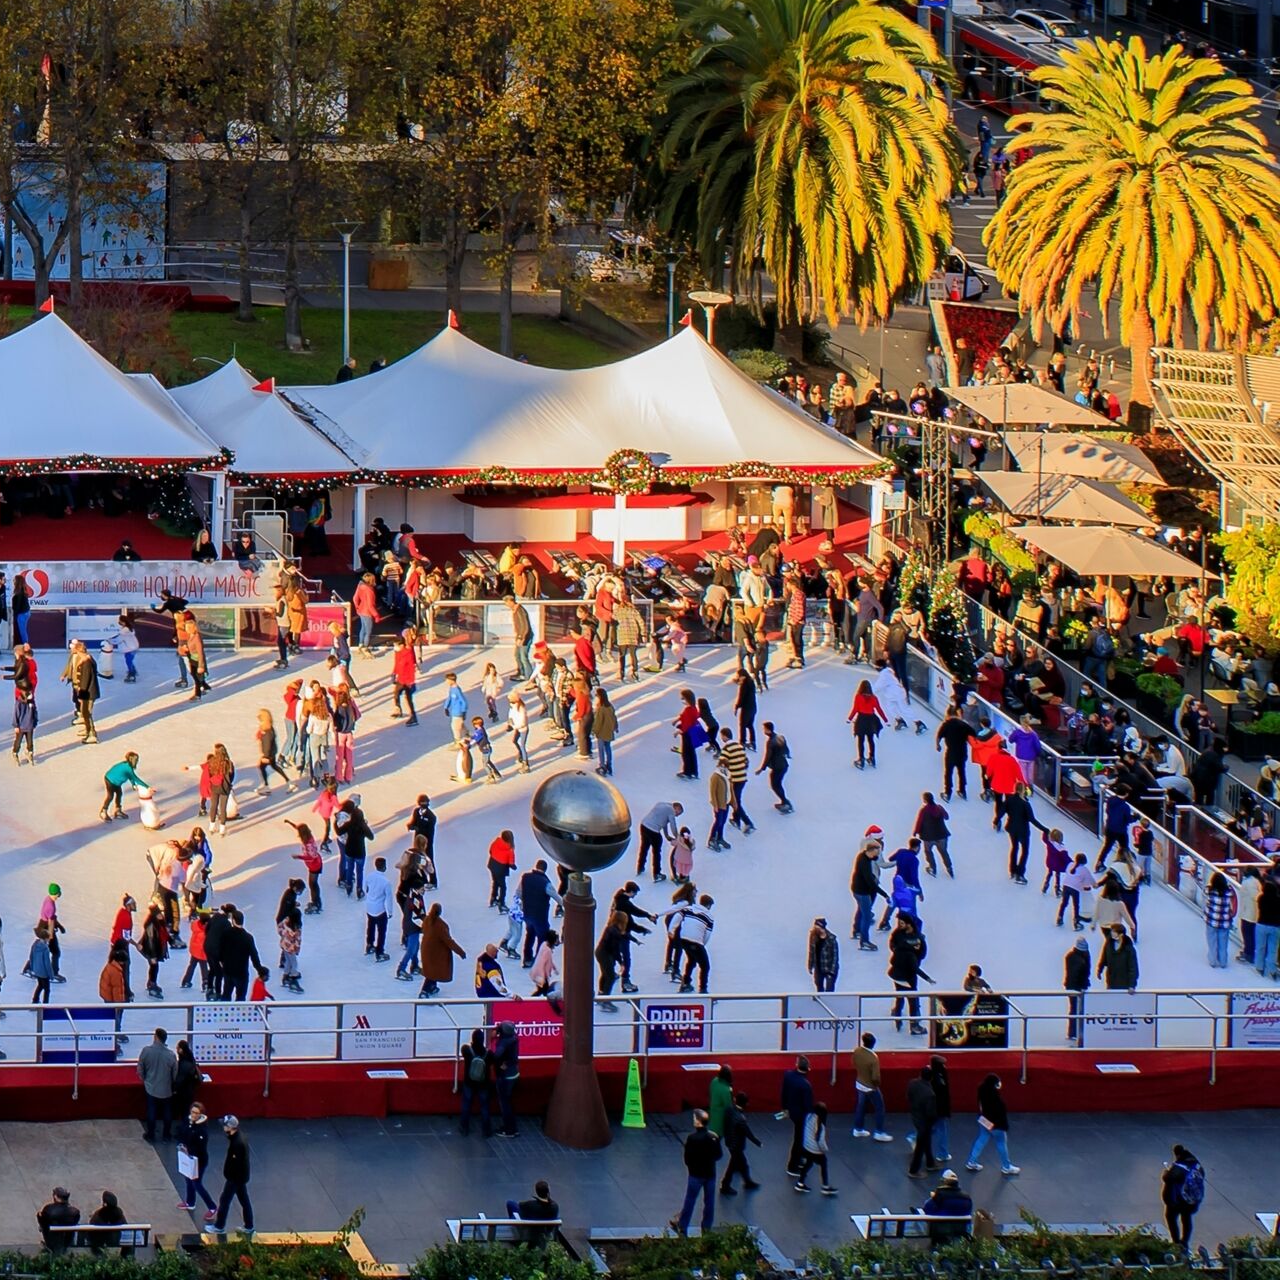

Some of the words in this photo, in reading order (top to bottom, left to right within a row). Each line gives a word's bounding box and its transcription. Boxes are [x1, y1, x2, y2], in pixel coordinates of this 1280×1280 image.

[63, 579, 88, 593] HOME
[93, 579, 111, 593] FOR
[114, 580, 138, 593] YOUR
[144, 575, 207, 599] HOLIDAY
[214, 575, 261, 598] MAGIC
[650, 1009, 701, 1031] PRIDE
[1086, 1013, 1138, 1025] HOTEL
